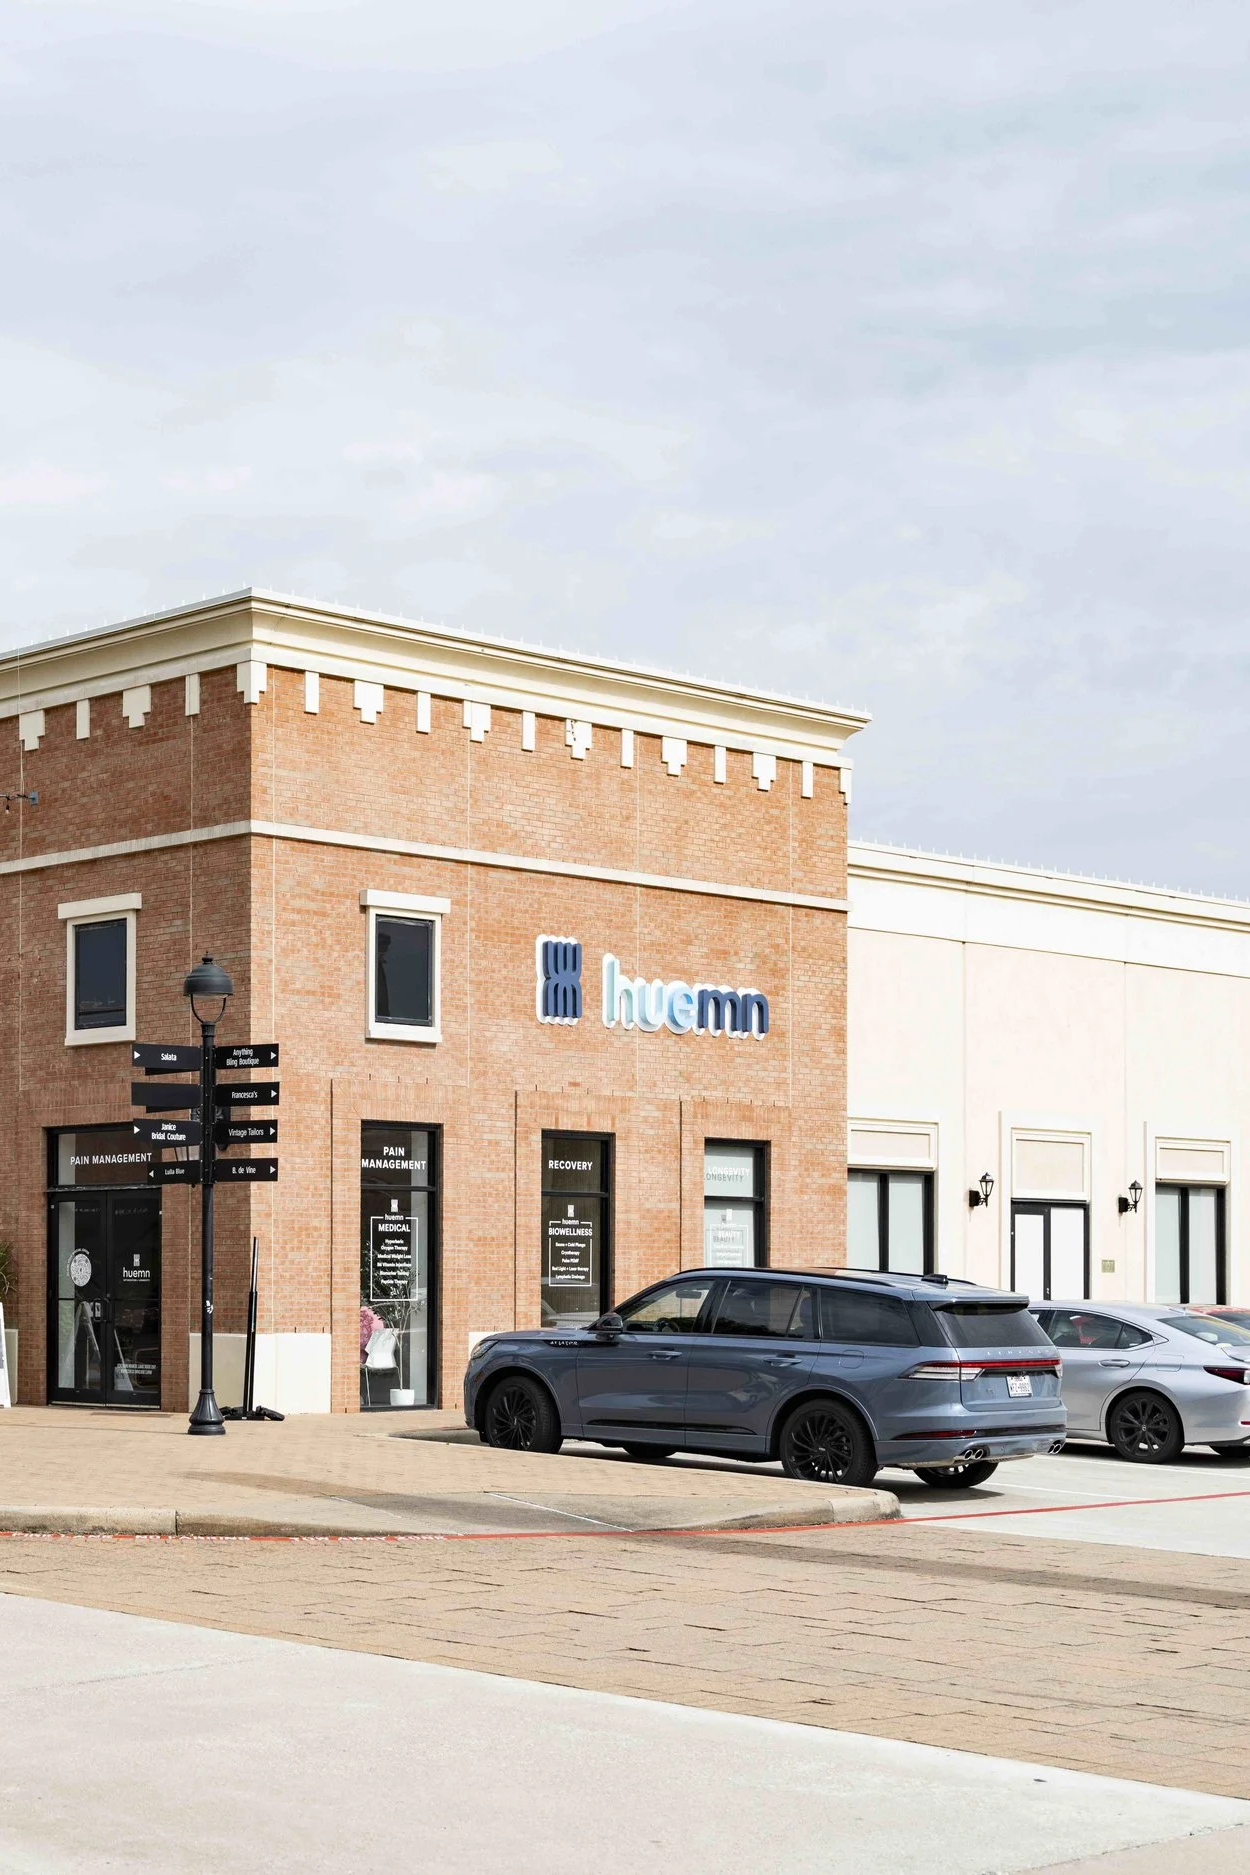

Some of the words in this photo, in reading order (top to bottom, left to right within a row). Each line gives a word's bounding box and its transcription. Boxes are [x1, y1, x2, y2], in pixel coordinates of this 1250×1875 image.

[603, 953, 769, 1039] huemn
[161, 1053, 177, 1061] Salata
[233, 1048, 253, 1057] Anything
[226, 1059, 238, 1067] Bling
[239, 1057, 260, 1066] Boutique
[231, 1091, 258, 1099] Francesca's
[161, 1123, 176, 1131] Janice
[151, 1132, 166, 1140] Bridal
[167, 1133, 186, 1141] Couture
[228, 1128, 247, 1138] Vintage
[248, 1128, 264, 1136] Tailors
[383, 1146, 405, 1157] PAIN
[70, 1156, 90, 1165] PAIN
[92, 1152, 152, 1164] MANAGEMENT
[361, 1159, 426, 1170] MANAGEMENT
[548, 1160, 593, 1170] RECOVERY
[238, 1166, 245, 1174] de
[246, 1166, 256, 1174] Vine
[378, 1223, 411, 1232] MEDICAL
[548, 1227, 593, 1236] BIOWELLNESS
[122, 1266, 151, 1278] huemn
